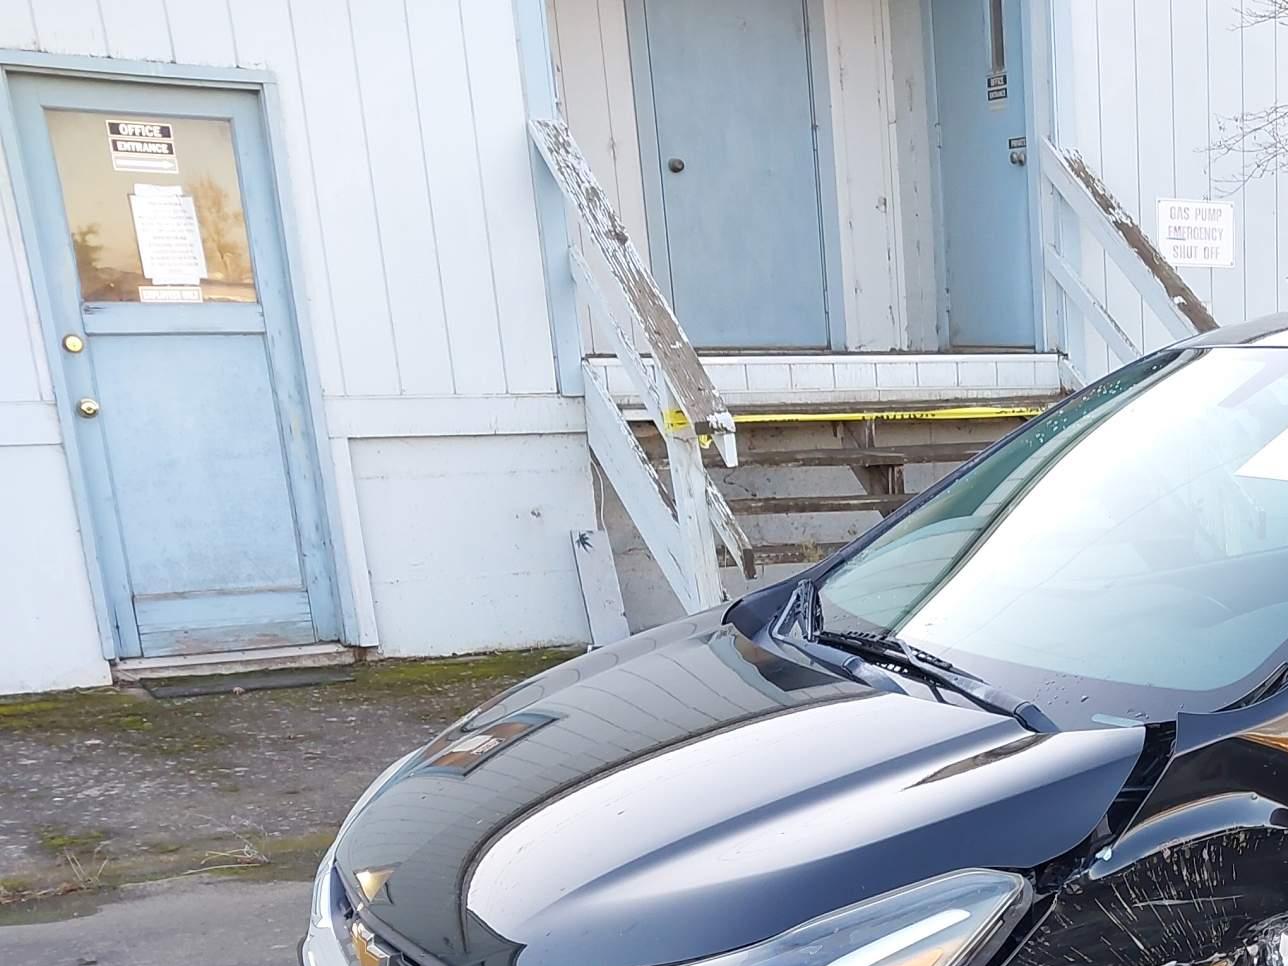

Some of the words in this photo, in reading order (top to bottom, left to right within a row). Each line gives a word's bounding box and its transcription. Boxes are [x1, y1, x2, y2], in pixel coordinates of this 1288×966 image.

[118, 123, 163, 138] OFFICE
[116, 141, 170, 154] ENTRANCE
[1169, 206, 1190, 221] GAS
[1194, 207, 1223, 223] PUMP
[1167, 225, 1224, 241] EMERGENCY
[1172, 244, 1199, 260] SHUT
[1203, 246, 1221, 260] OFF
